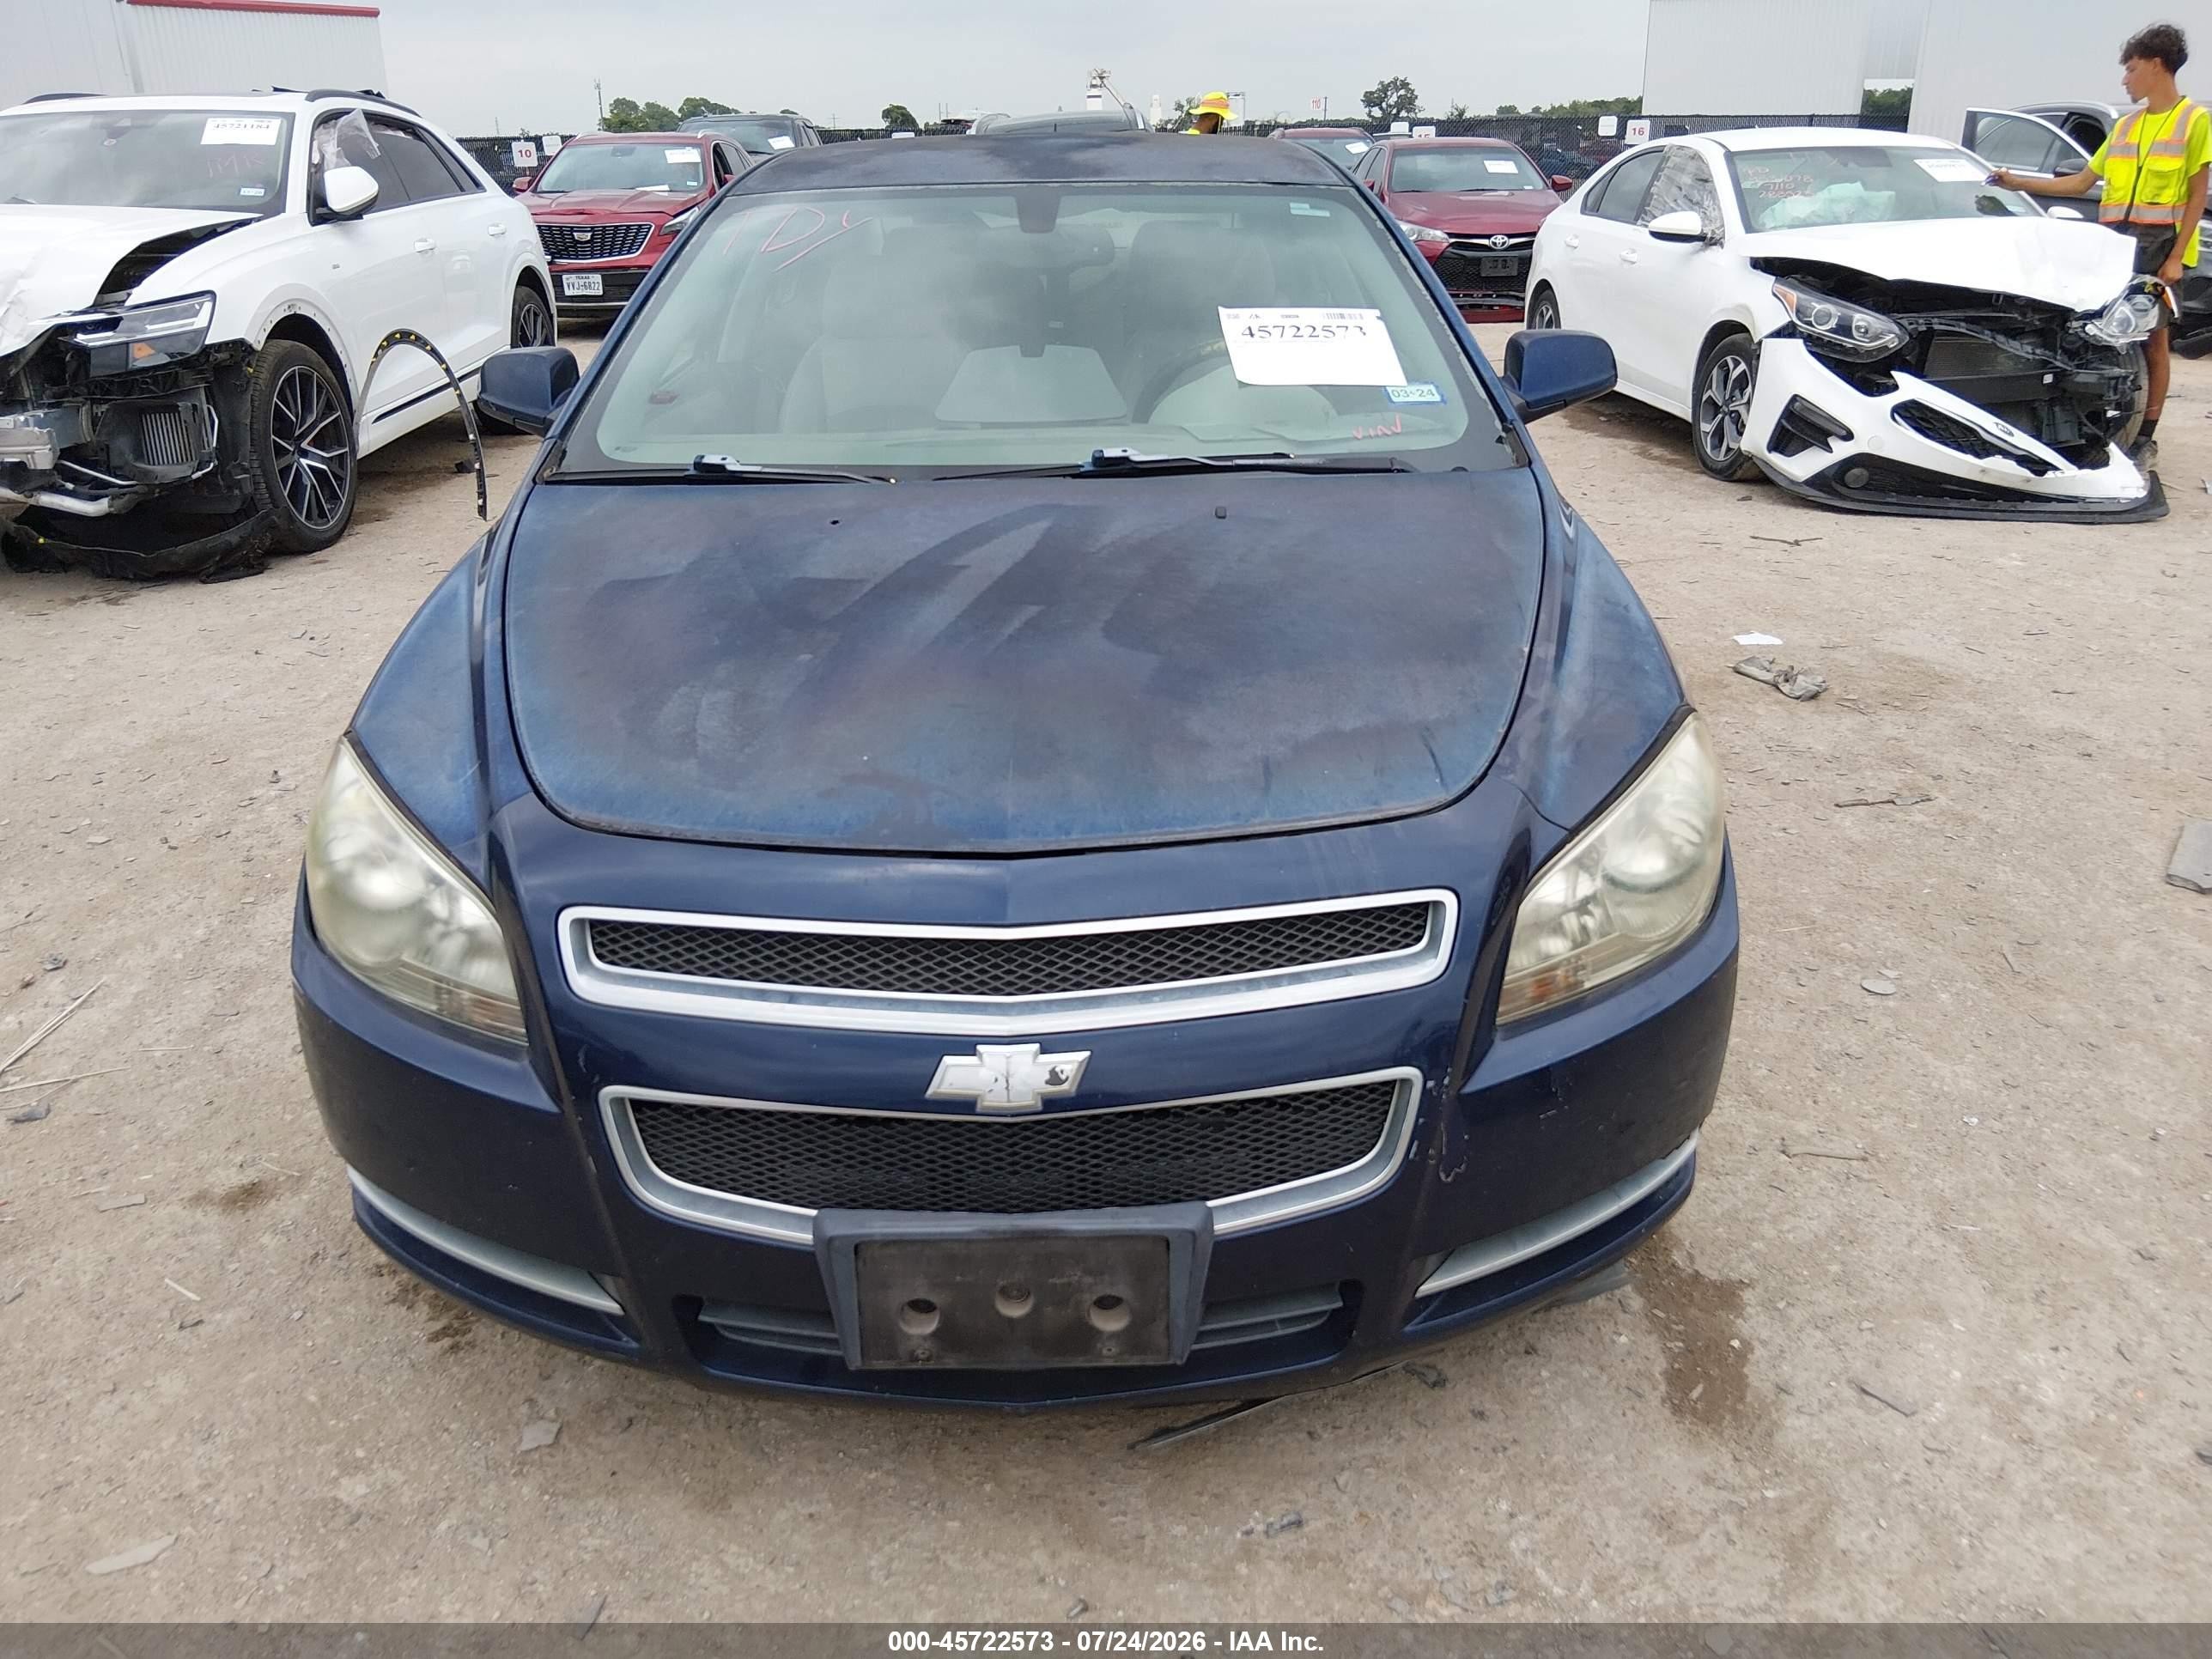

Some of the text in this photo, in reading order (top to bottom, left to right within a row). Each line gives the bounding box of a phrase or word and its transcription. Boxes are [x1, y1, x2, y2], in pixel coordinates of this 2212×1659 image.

[1632, 127, 1644, 137] 16
[518, 149, 532, 158] 10
[1242, 325, 1367, 338] 45722573
